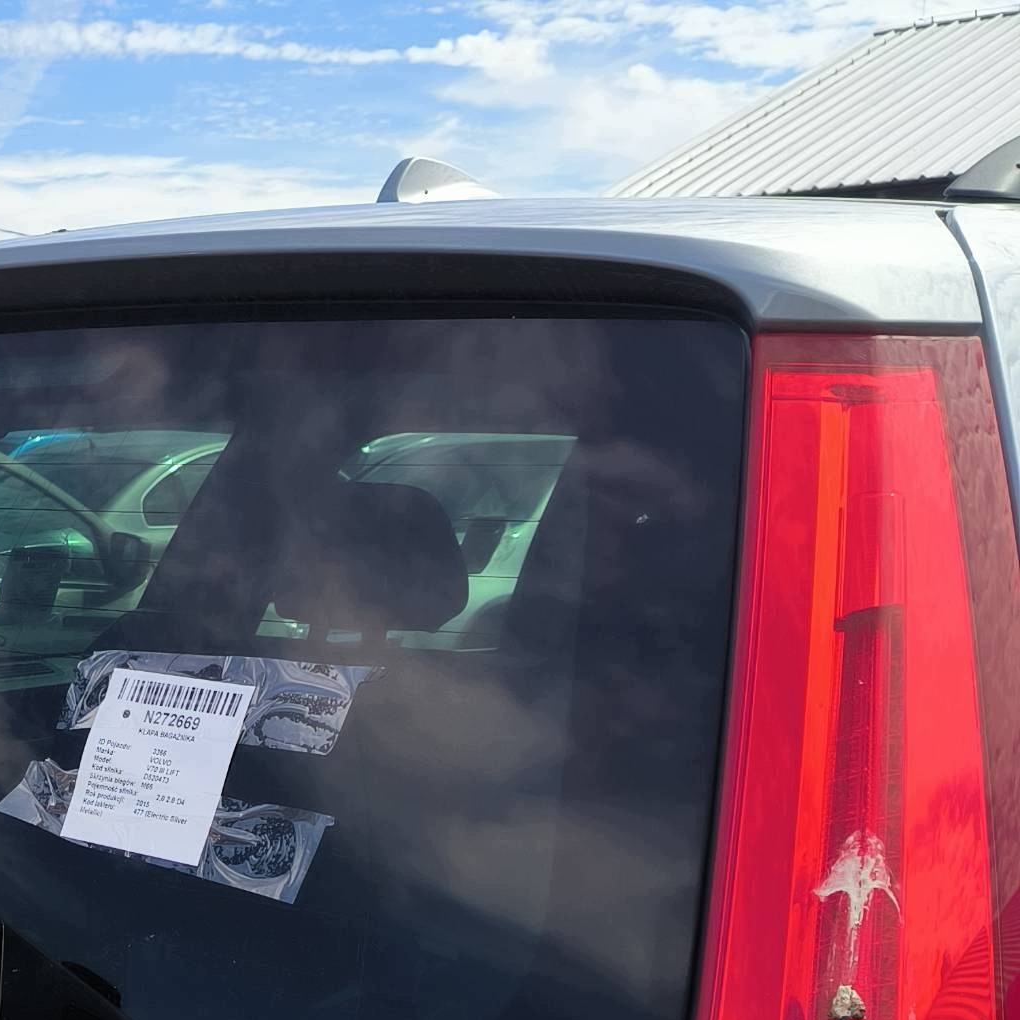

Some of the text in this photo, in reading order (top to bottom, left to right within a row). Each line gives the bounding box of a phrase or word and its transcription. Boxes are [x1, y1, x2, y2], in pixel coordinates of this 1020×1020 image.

[144, 710, 201, 731] N272669
[138, 728, 159, 737] KLAPA
[94, 754, 112, 764] Model:
[146, 764, 159, 773] V70
[166, 768, 181, 777] LIFT
[96, 746, 172, 766] Marka: VOLVO
[91, 763, 104, 771] Kod
[89, 772, 114, 783] Skrzynia
[85, 788, 96, 797] Rok
[136, 799, 150, 808] 2015
[82, 797, 95, 806] Kod
[133, 808, 144, 816] 477
[169, 815, 188, 825] Silver
